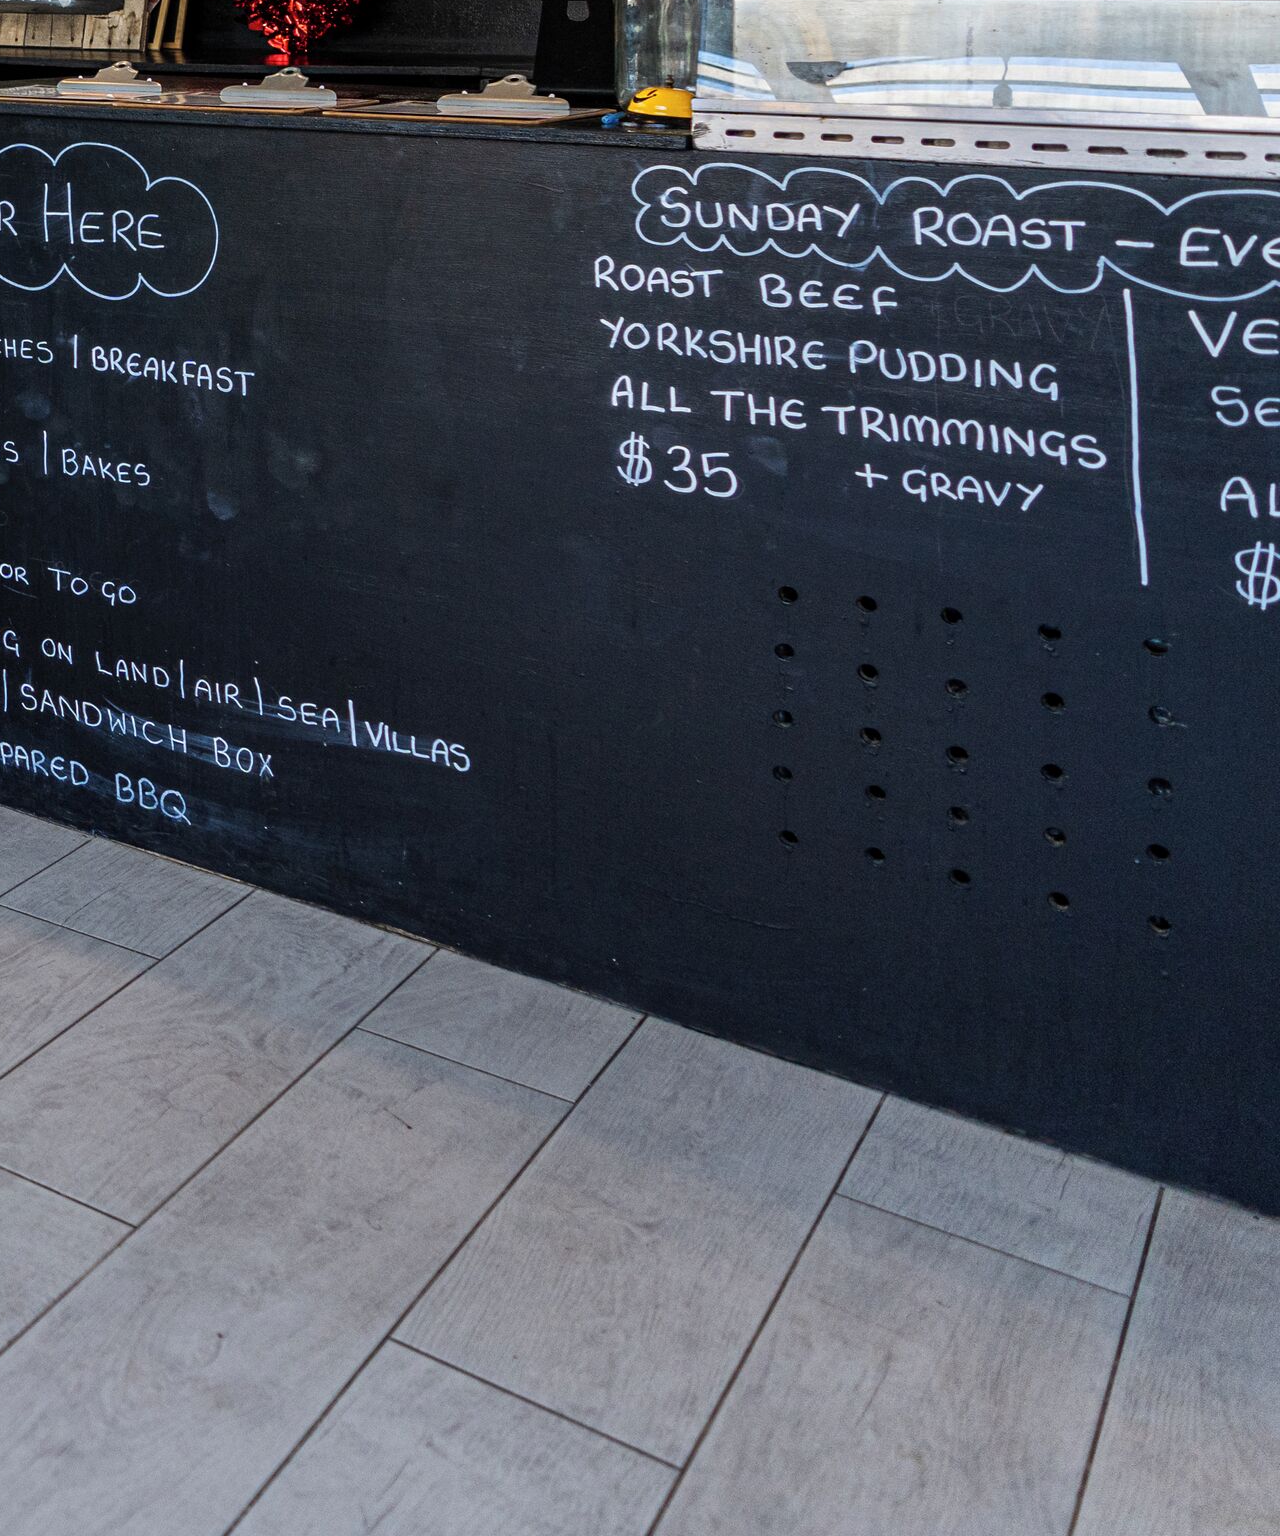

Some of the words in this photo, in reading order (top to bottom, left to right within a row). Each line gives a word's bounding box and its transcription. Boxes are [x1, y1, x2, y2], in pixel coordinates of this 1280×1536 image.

[42, 182, 165, 251] HERE
[659, 187, 861, 237] SUNDAY
[913, 207, 1086, 252] ROAST
[594, 257, 724, 299] ROAST
[760, 273, 899, 315] BEEF
[90, 346, 255, 396] BREAKFAST
[600, 316, 827, 370] YORKSHIRE
[849, 340, 1059, 401] PUDDING
[611, 375, 692, 414] ALL
[711, 390, 807, 430] THE
[821, 406, 1107, 470] TRIMMINGS
[61, 450, 152, 486] BAKES
[616, 432, 738, 497] $35
[901, 469, 1044, 511] GRAVY
[0, 561, 30, 586] OR
[46, 568, 90, 597] TO
[101, 580, 137, 607] GO
[20, 684, 188, 754] SANDWICH
[212, 736, 274, 778] BOX
[41, 637, 74, 665] ON
[95, 651, 170, 690] LAND
[194, 677, 241, 709] AIR
[277, 698, 340, 734] SEA
[363, 720, 472, 773] VILLAS
[114, 773, 193, 827] BBQ
